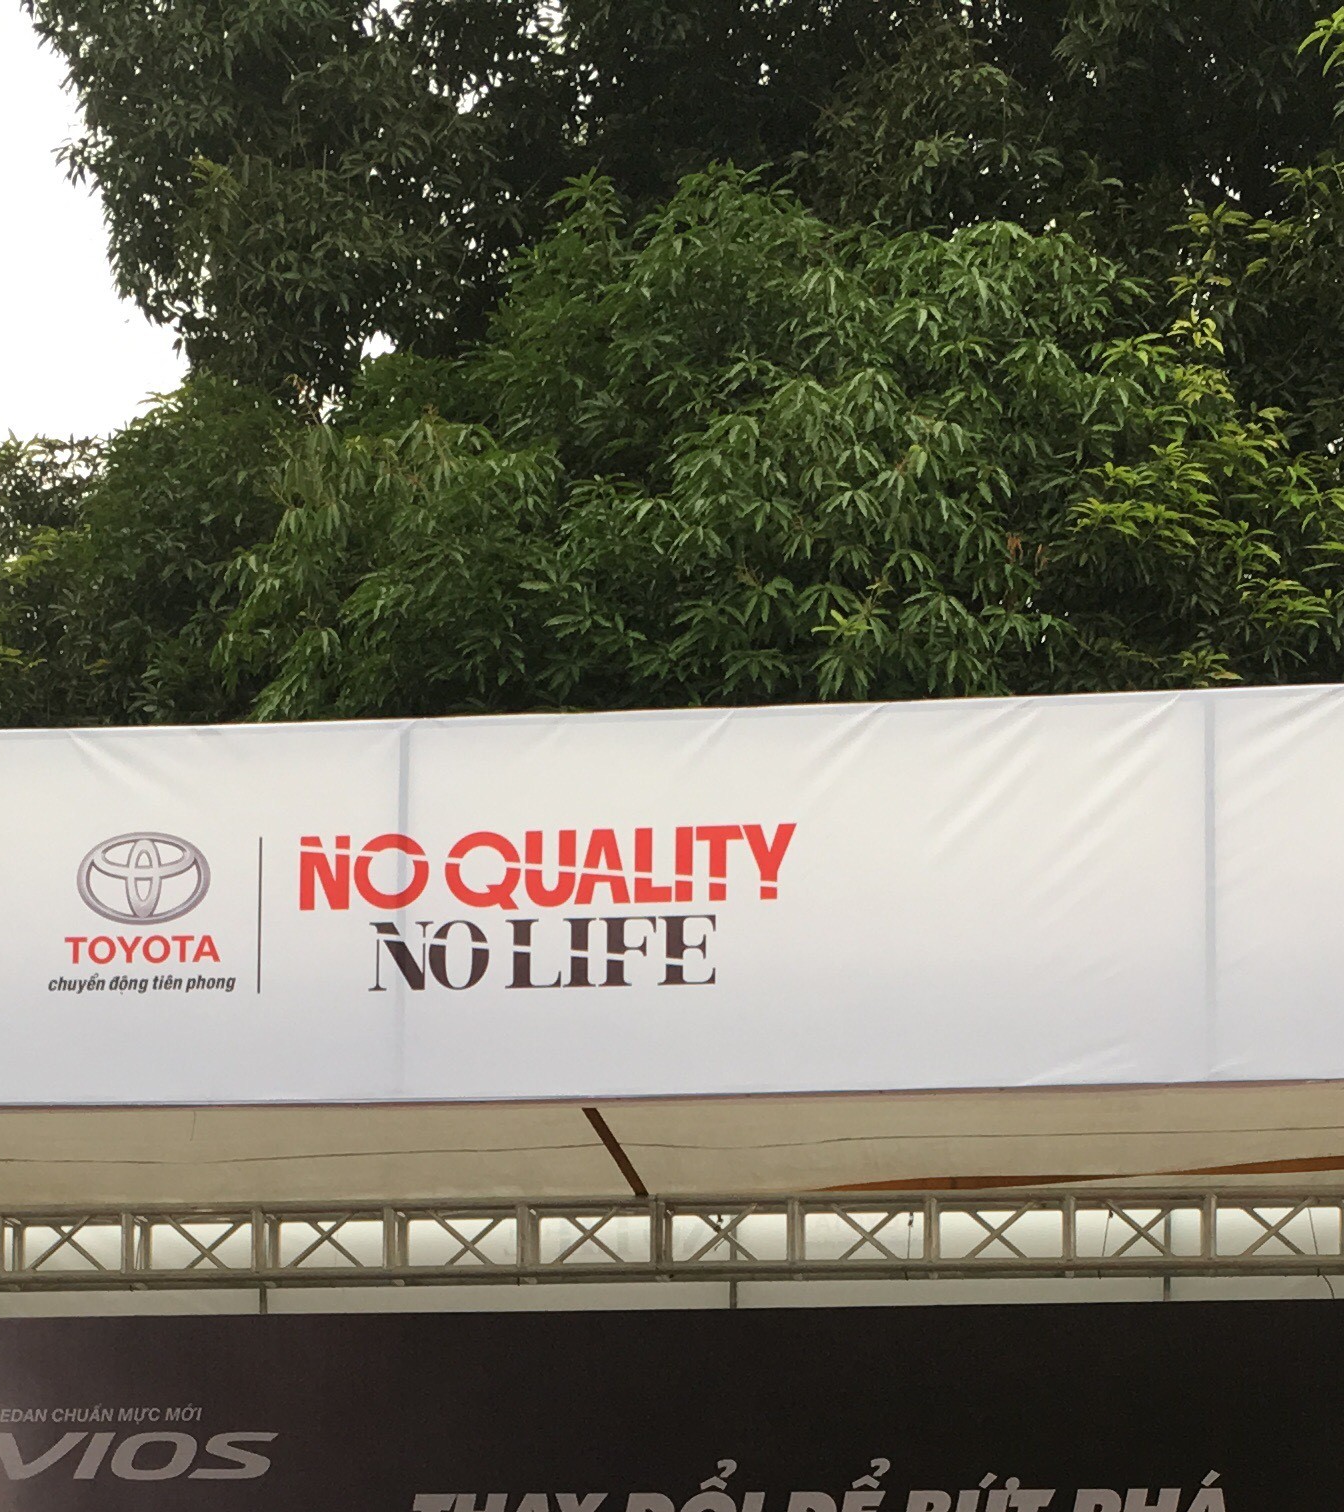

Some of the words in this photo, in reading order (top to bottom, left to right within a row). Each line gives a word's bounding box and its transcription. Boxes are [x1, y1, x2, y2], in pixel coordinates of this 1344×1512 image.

[298, 833, 429, 911] NO
[444, 822, 798, 911] QUALITY
[64, 935, 221, 965] TOYOTA
[368, 919, 489, 993] NO
[504, 914, 717, 991] LIFE
[48, 972, 106, 994] chuyển
[109, 975, 148, 995] động
[152, 975, 184, 991] tiên
[185, 974, 236, 993] phong
[51, 1403, 114, 1423] CHUẨN
[117, 1407, 161, 1425] MỰC
[164, 1402, 203, 1422] MỚI
